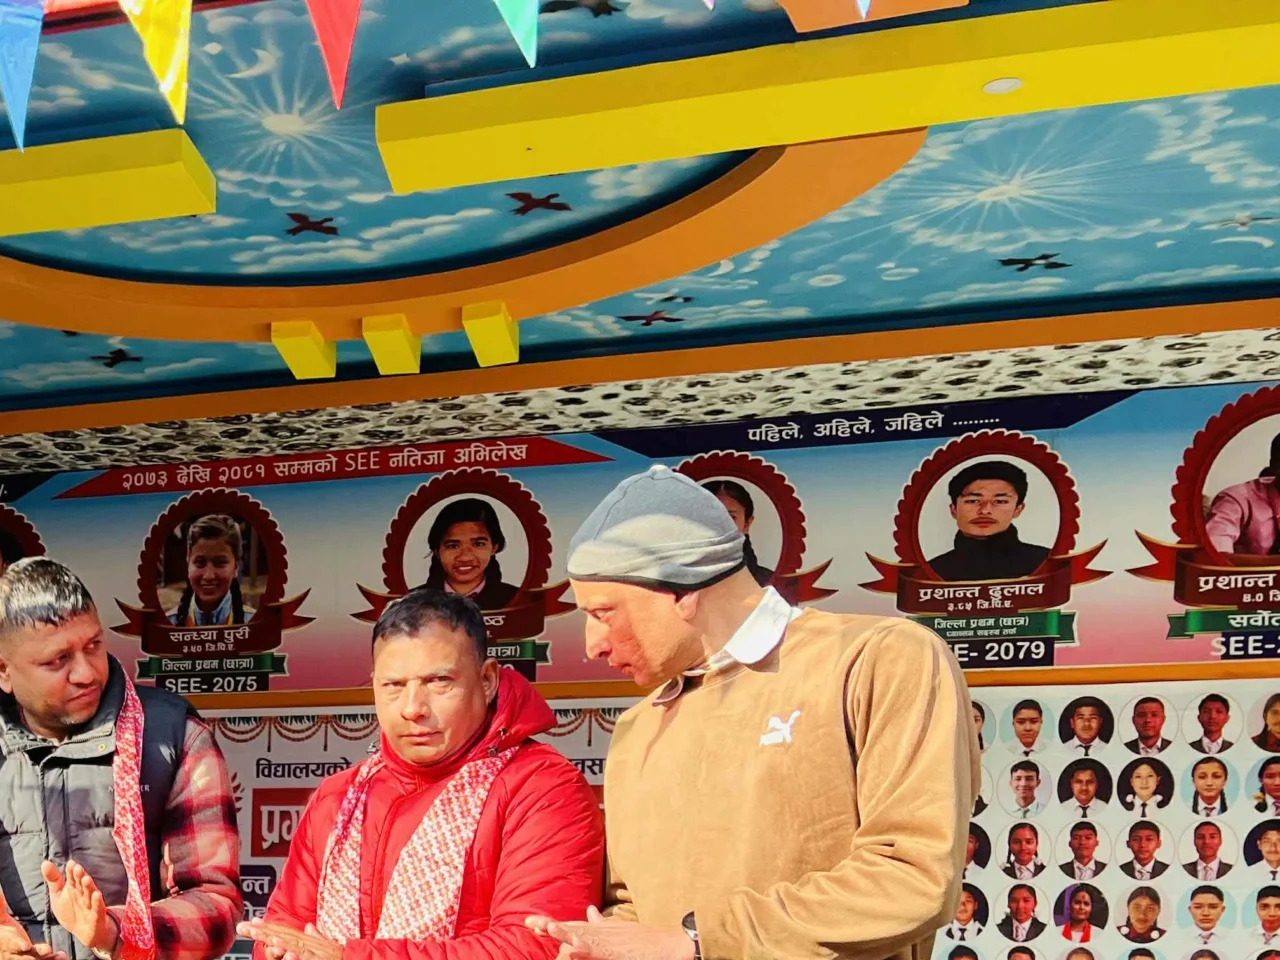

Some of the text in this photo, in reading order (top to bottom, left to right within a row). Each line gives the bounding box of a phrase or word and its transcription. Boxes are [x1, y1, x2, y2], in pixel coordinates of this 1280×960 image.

[748, 422, 804, 443] पहिले,
[813, 417, 875, 437] अहिले,
[884, 411, 944, 432] जहिले
[122, 442, 528, 490] २०७३ देखि २०८१ सम्मको SEE नतिजा अभिलेख
[1198, 573, 1277, 592] प्रशान्त
[919, 583, 1045, 602] प्रशान्त दुलाल
[935, 618, 966, 629] जिल्ला
[223, 626, 251, 643] पुरी
[985, 641, 1046, 661] 2079
[162, 659, 192, 671] जिल्ला
[165, 676, 257, 693] SEE- 2075
